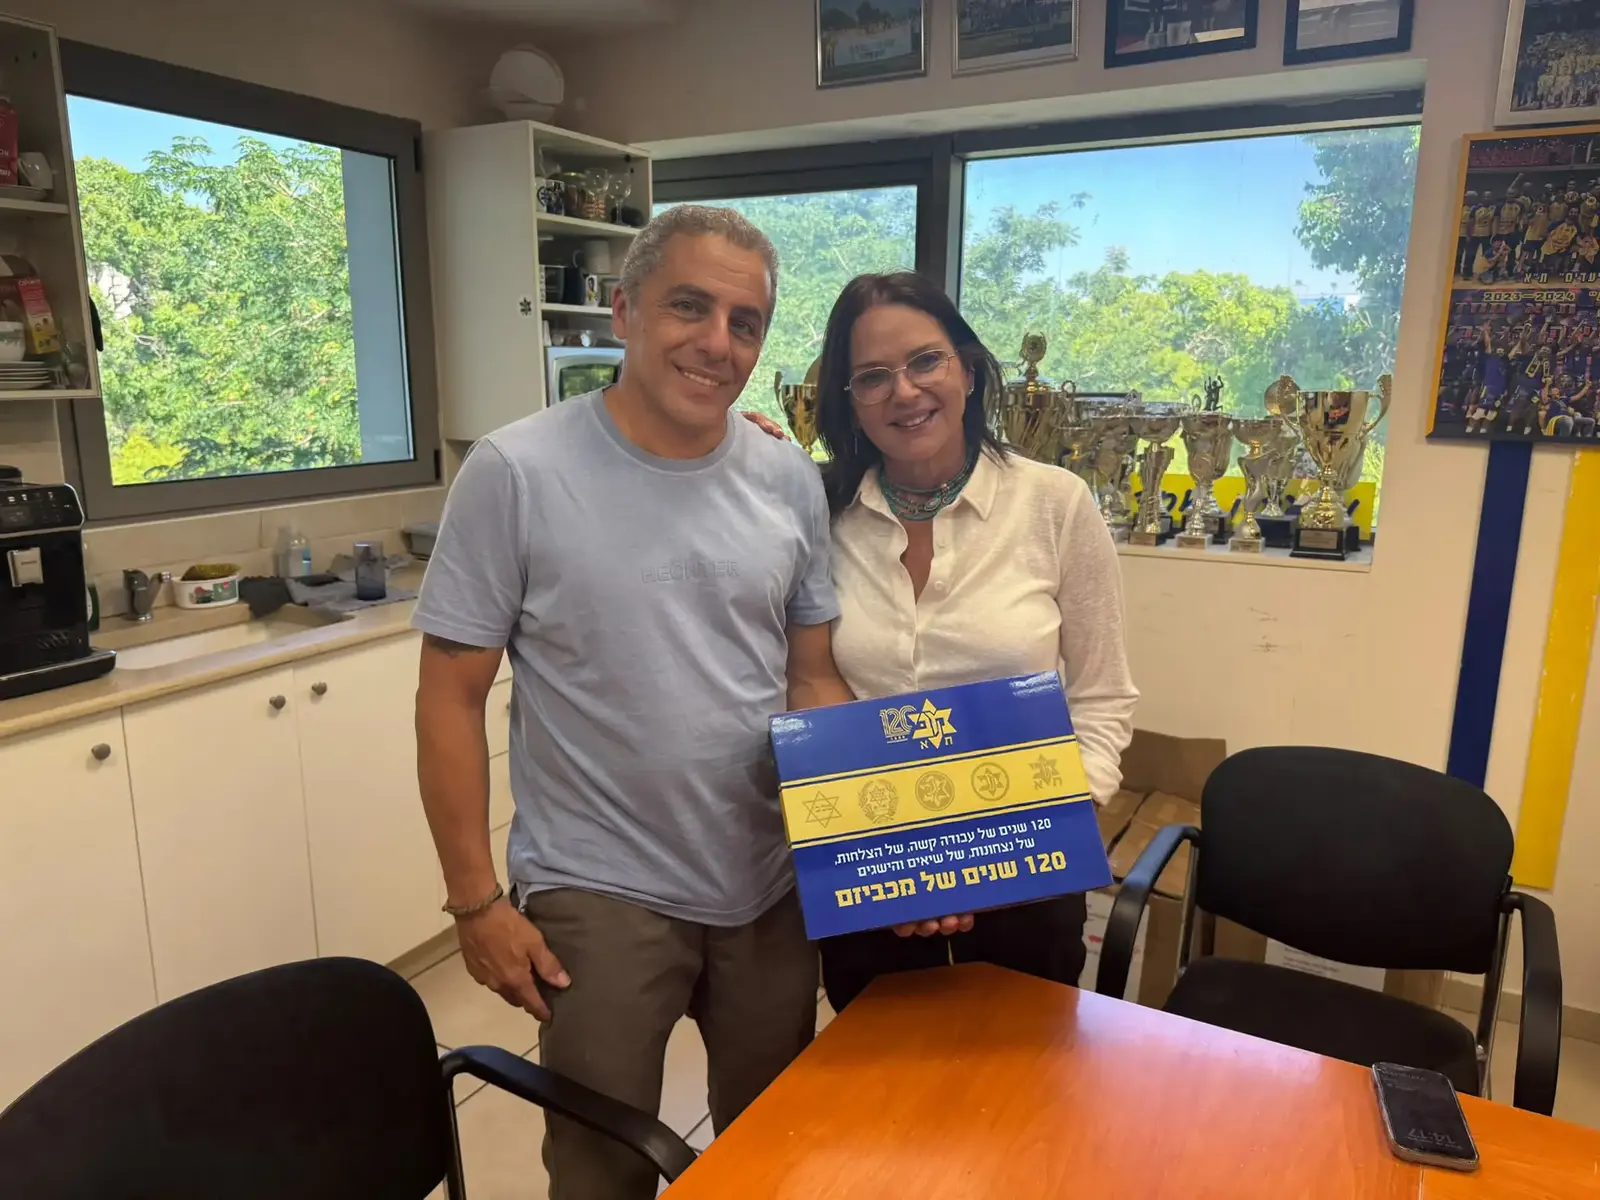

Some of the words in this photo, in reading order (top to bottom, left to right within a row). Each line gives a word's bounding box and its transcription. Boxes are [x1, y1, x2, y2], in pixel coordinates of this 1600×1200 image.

[998, 822, 1028, 836] שנים
[1030, 818, 1052, 831] 120
[939, 831, 975, 847] עבודה
[976, 827, 997, 840] של
[884, 843, 904, 855] של
[907, 838, 937, 853] קשה,
[968, 840, 1014, 859] נצחונות,
[1015, 837, 1035, 850] של
[834, 847, 883, 866] הצלחות,
[906, 853, 944, 869] שיאים
[945, 848, 965, 861] של
[1024, 850, 1067, 875] 120
[857, 859, 905, 877] והישגים
[961, 860, 1018, 886] שנים
[919, 870, 957, 892] של
[834, 878, 917, 908] מכביזם
